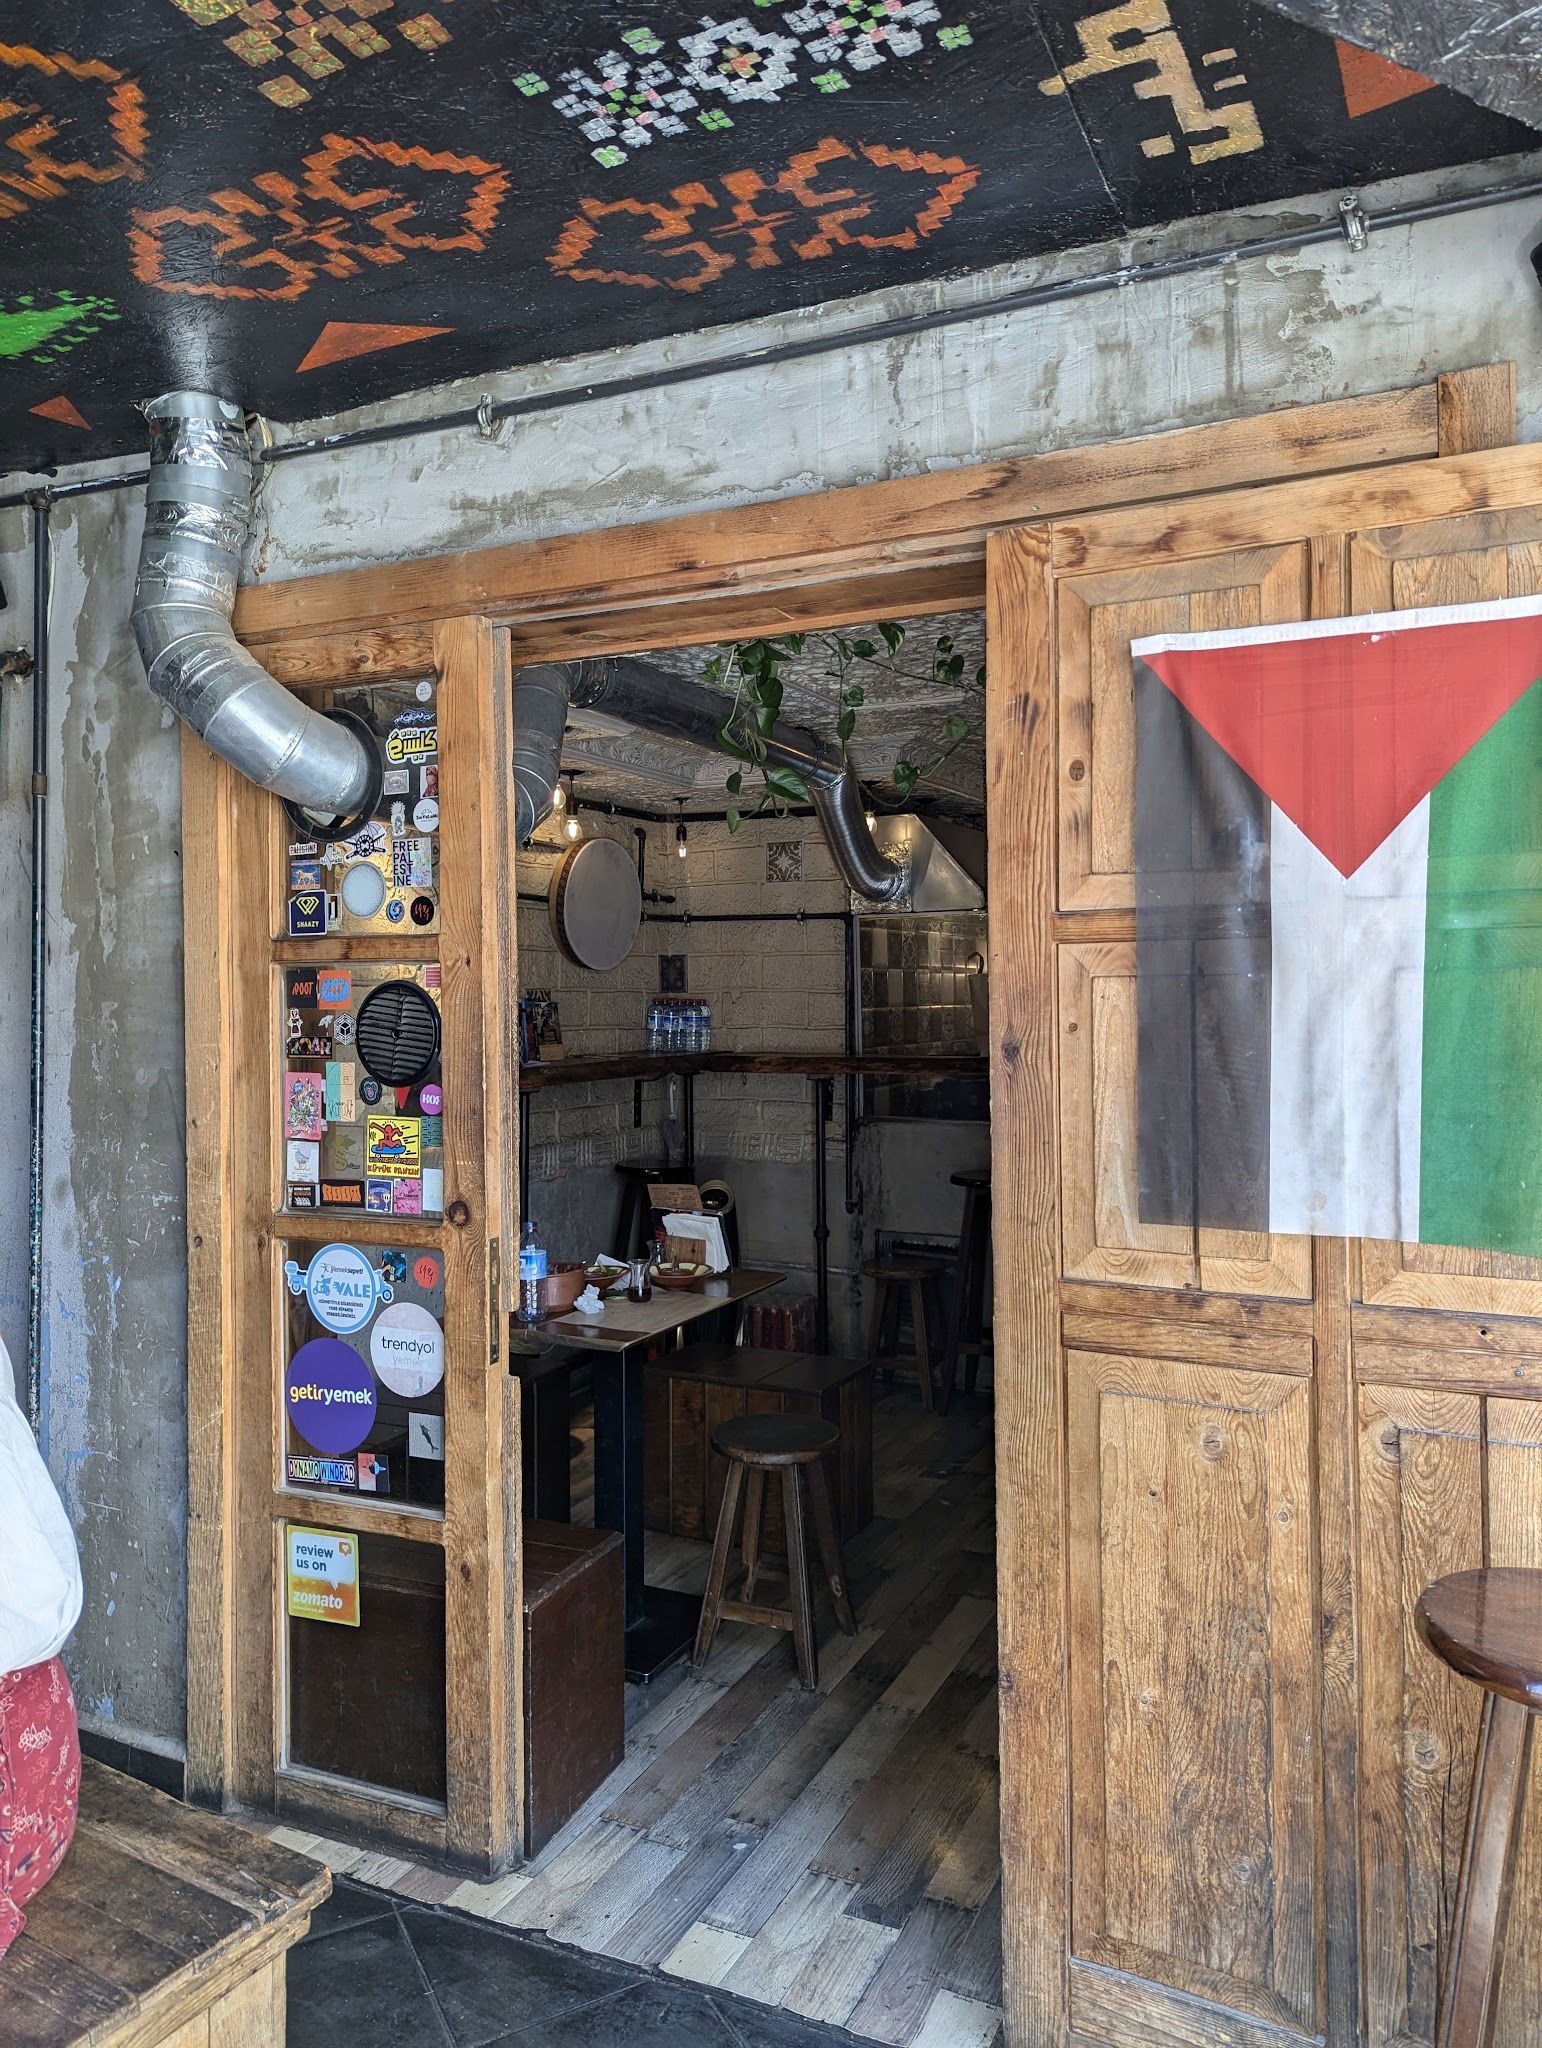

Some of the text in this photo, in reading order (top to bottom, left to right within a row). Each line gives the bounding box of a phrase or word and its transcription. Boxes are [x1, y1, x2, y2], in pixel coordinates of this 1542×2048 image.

[290, 844, 317, 854] PALESTINE
[392, 840, 419, 852] FREE
[393, 852, 413, 863] PAL
[393, 864, 413, 875] EST
[393, 875, 412, 886] INE
[292, 982, 314, 996] ROOT
[332, 1281, 371, 1298] VALE
[381, 1336, 435, 1355] trendyol
[290, 1384, 373, 1405] getiryemek
[288, 1459, 355, 1483] DYNAMO WINDRAD
[296, 1545, 334, 1558] review
[296, 1559, 327, 1572] us on
[293, 1591, 343, 1609] zomato
